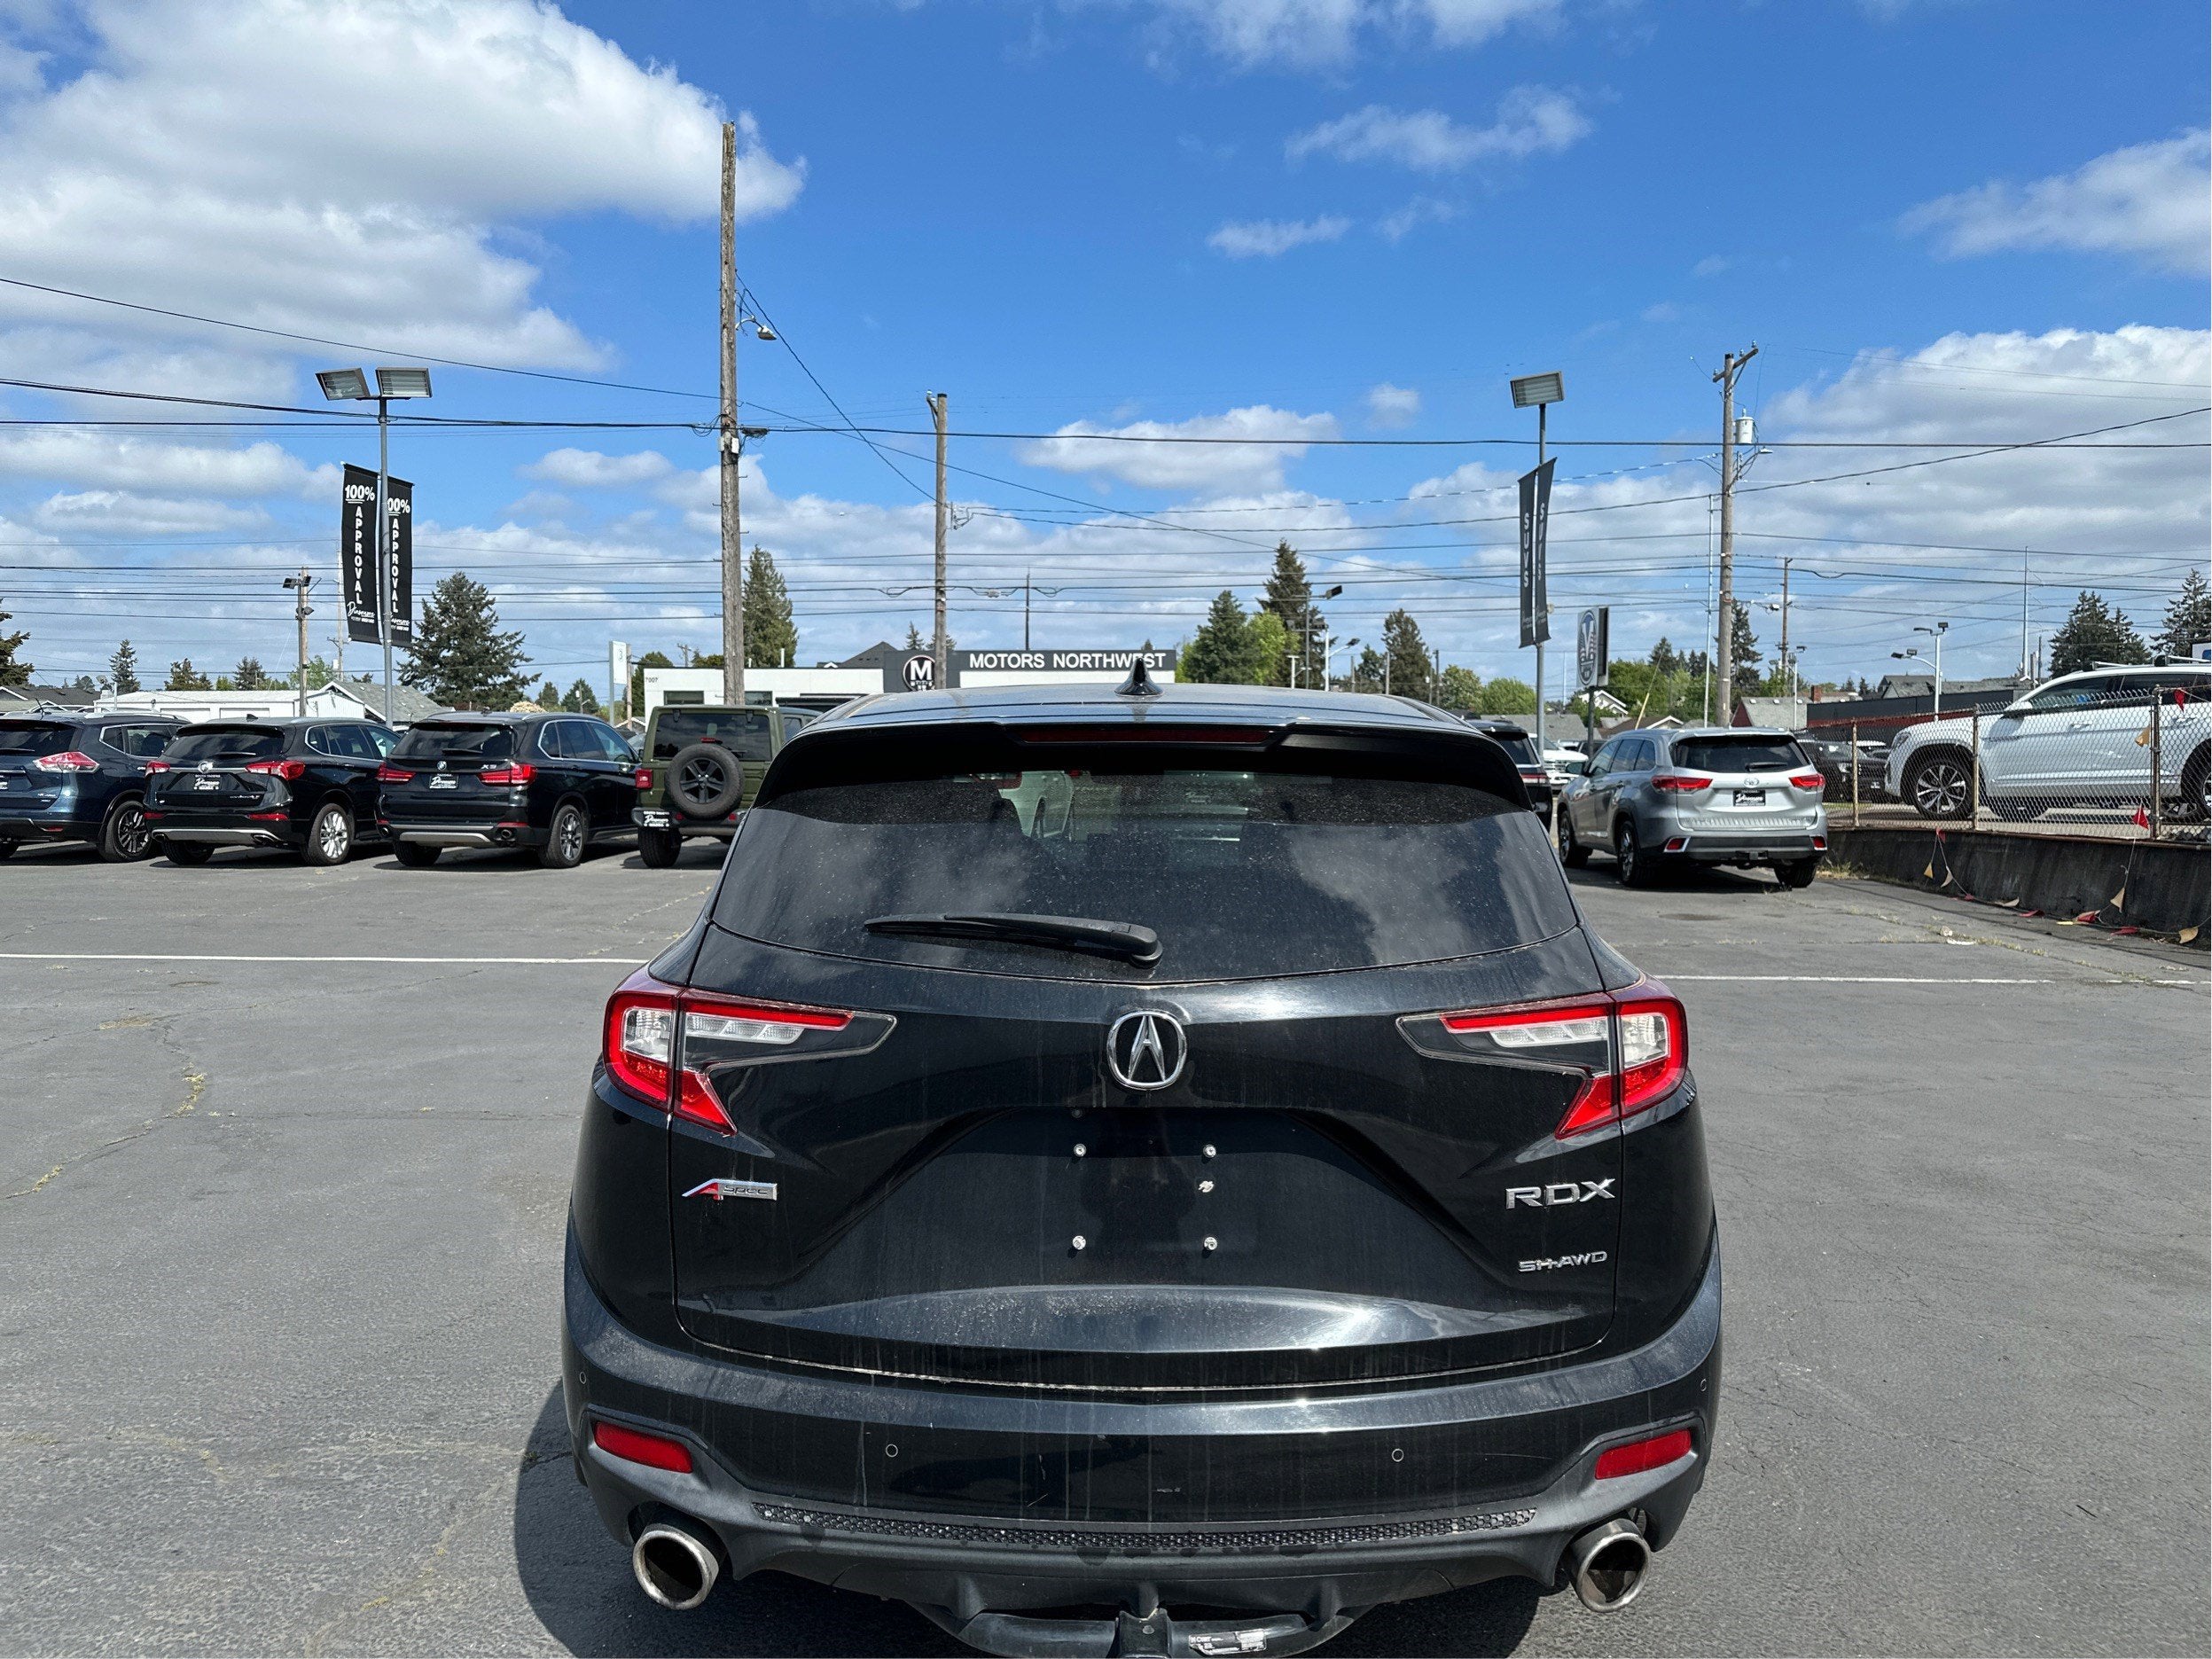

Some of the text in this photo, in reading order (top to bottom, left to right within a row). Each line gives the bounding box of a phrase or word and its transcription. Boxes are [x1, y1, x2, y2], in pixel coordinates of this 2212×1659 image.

[345, 485, 375, 501] 100%
[387, 497, 410, 513] 00%
[969, 653, 1045, 669] MOTORS
[1505, 1178, 1615, 1209] RDX
[1518, 1250, 1607, 1272] SH-AWD
